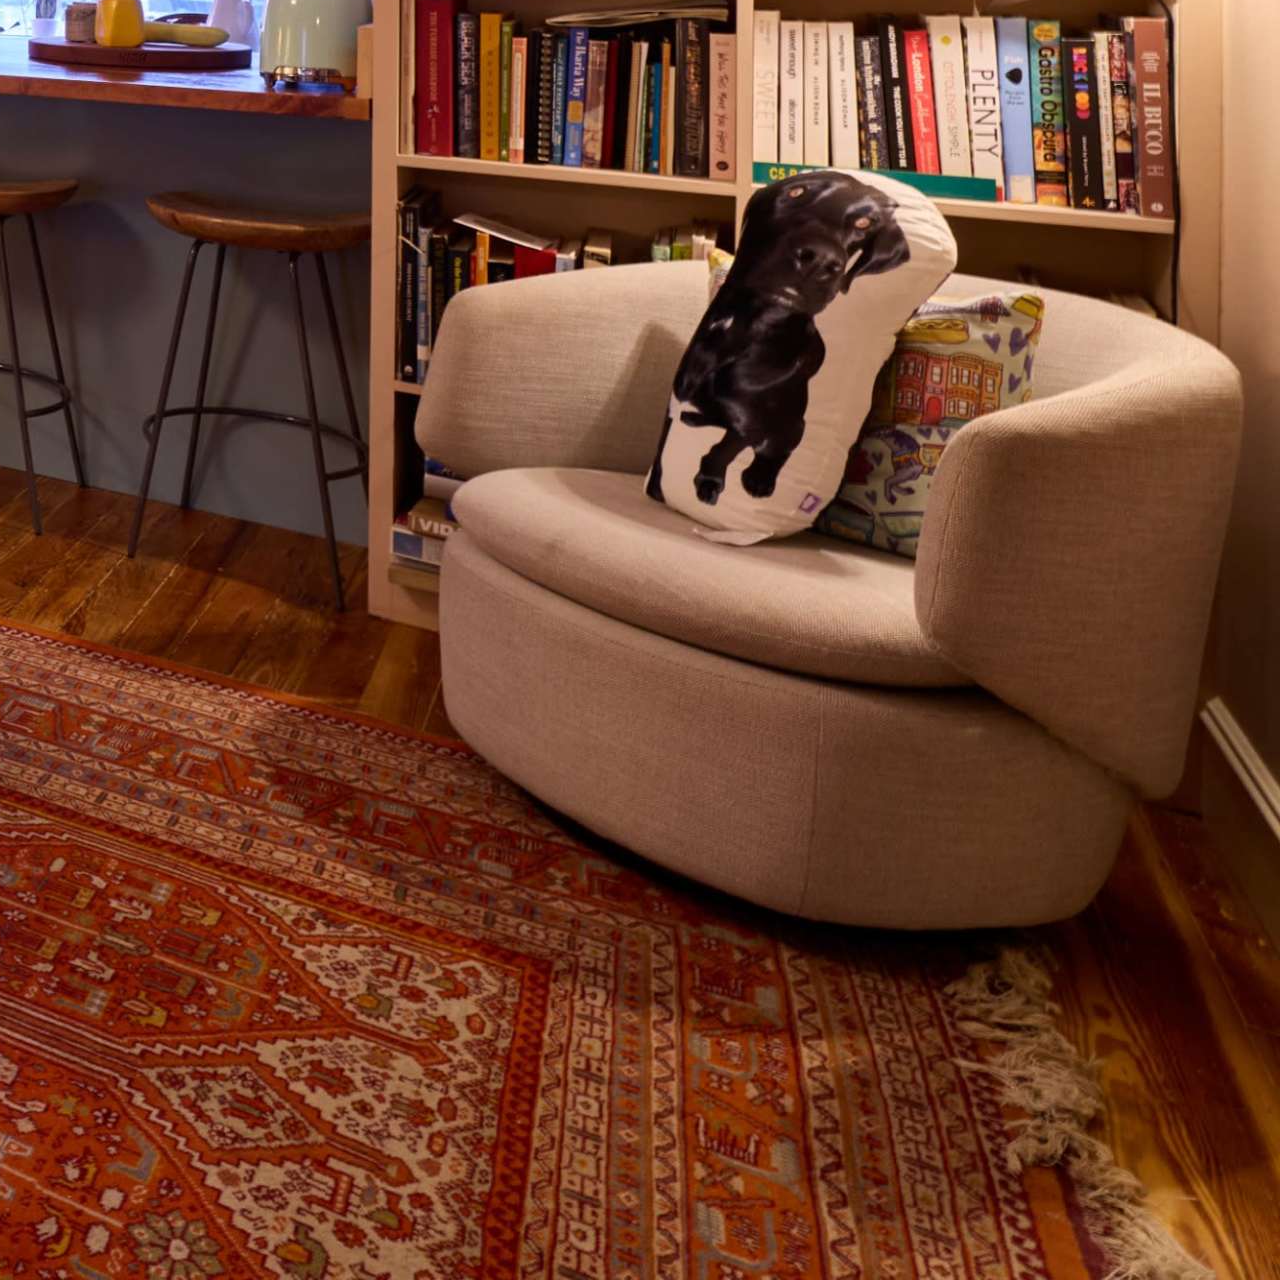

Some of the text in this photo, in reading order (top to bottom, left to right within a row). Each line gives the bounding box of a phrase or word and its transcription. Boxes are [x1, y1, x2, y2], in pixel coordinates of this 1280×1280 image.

[461, 21, 473, 86] BLACK SEA
[574, 46, 586, 76] Ikaria
[785, 29, 797, 79] sweet enough
[912, 53, 924, 92] London
[570, 78, 584, 97] Way
[756, 70, 775, 134] SWEET
[812, 76, 820, 100] ALISON
[893, 86, 901, 99] THE
[1038, 47, 1058, 163] Gastro Obscura
[895, 118, 903, 131] YOU
[971, 69, 999, 158] PLENTY
[1143, 82, 1163, 156] IL BUCO
[947, 126, 961, 159] SIMPLE
